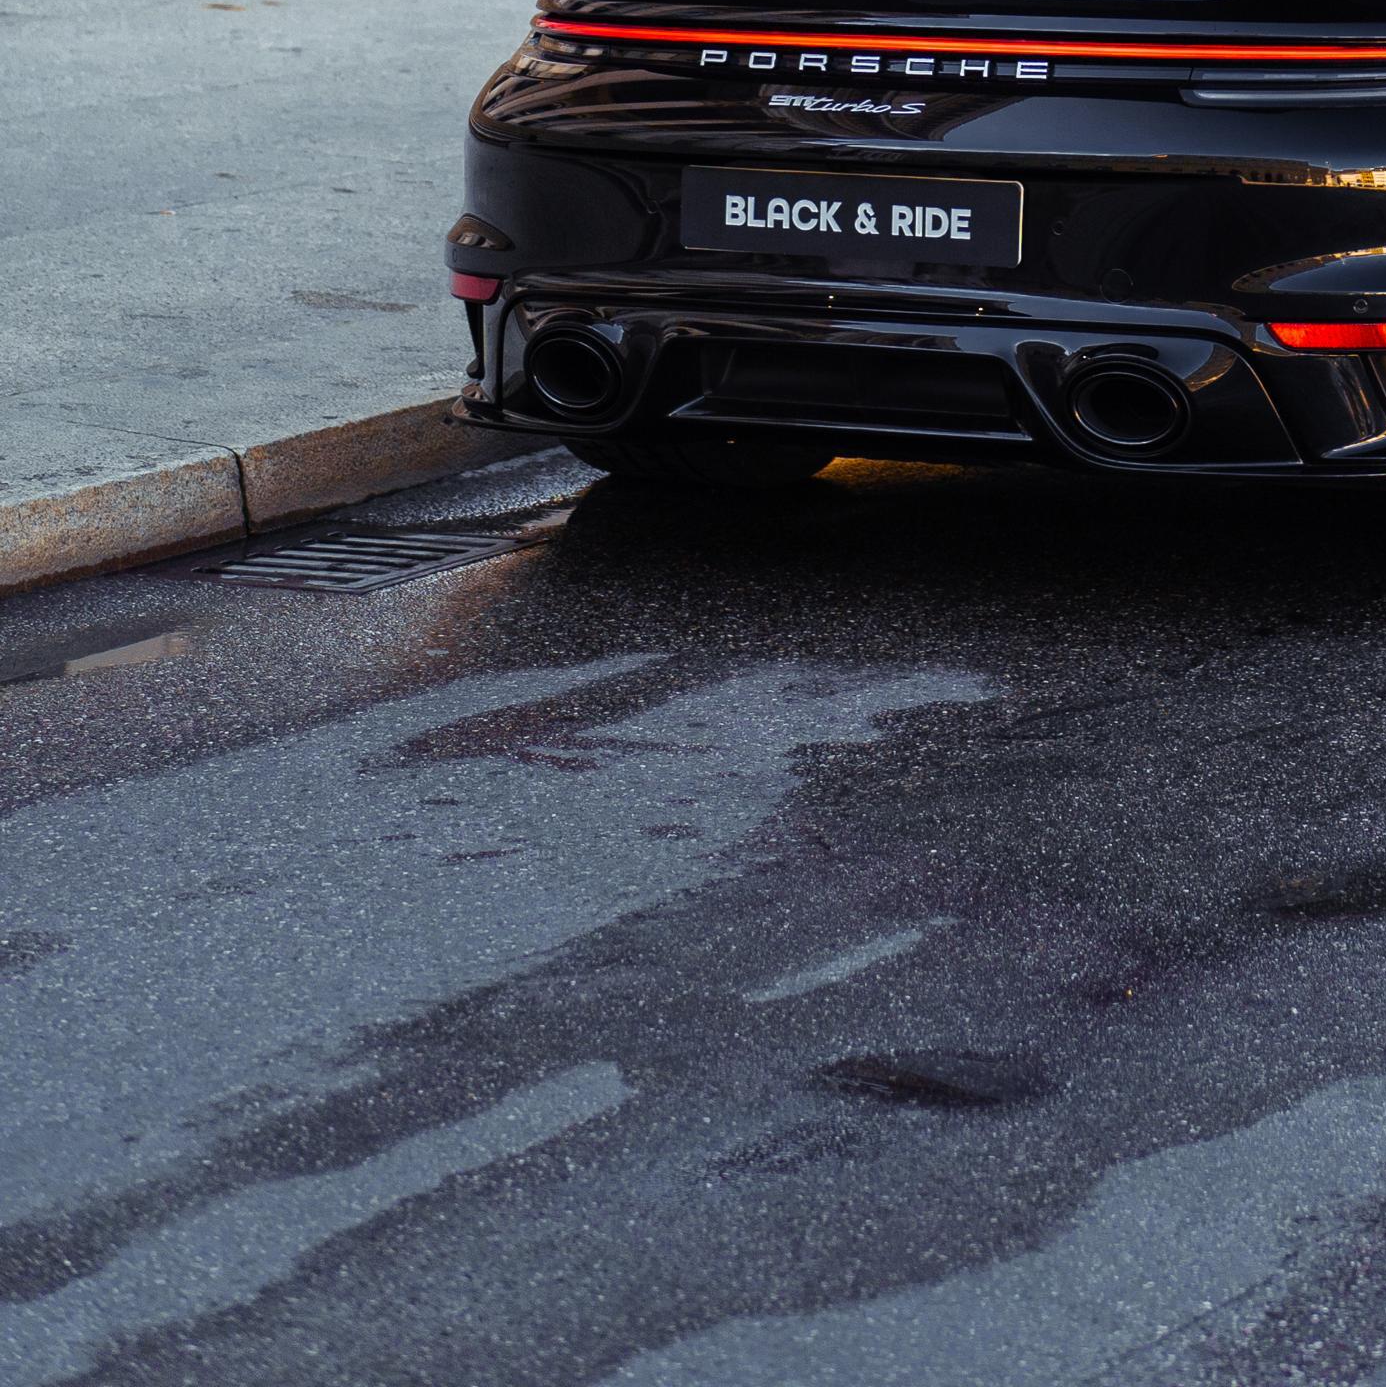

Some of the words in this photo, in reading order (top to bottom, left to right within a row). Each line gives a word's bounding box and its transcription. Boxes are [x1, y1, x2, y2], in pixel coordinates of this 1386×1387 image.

[700, 49, 1049, 79] PORSCHE
[805, 97, 892, 114] turbo
[890, 102, 926, 115] S
[725, 194, 843, 234] BLACK
[854, 201, 880, 236] &
[891, 204, 972, 241] RIDE
